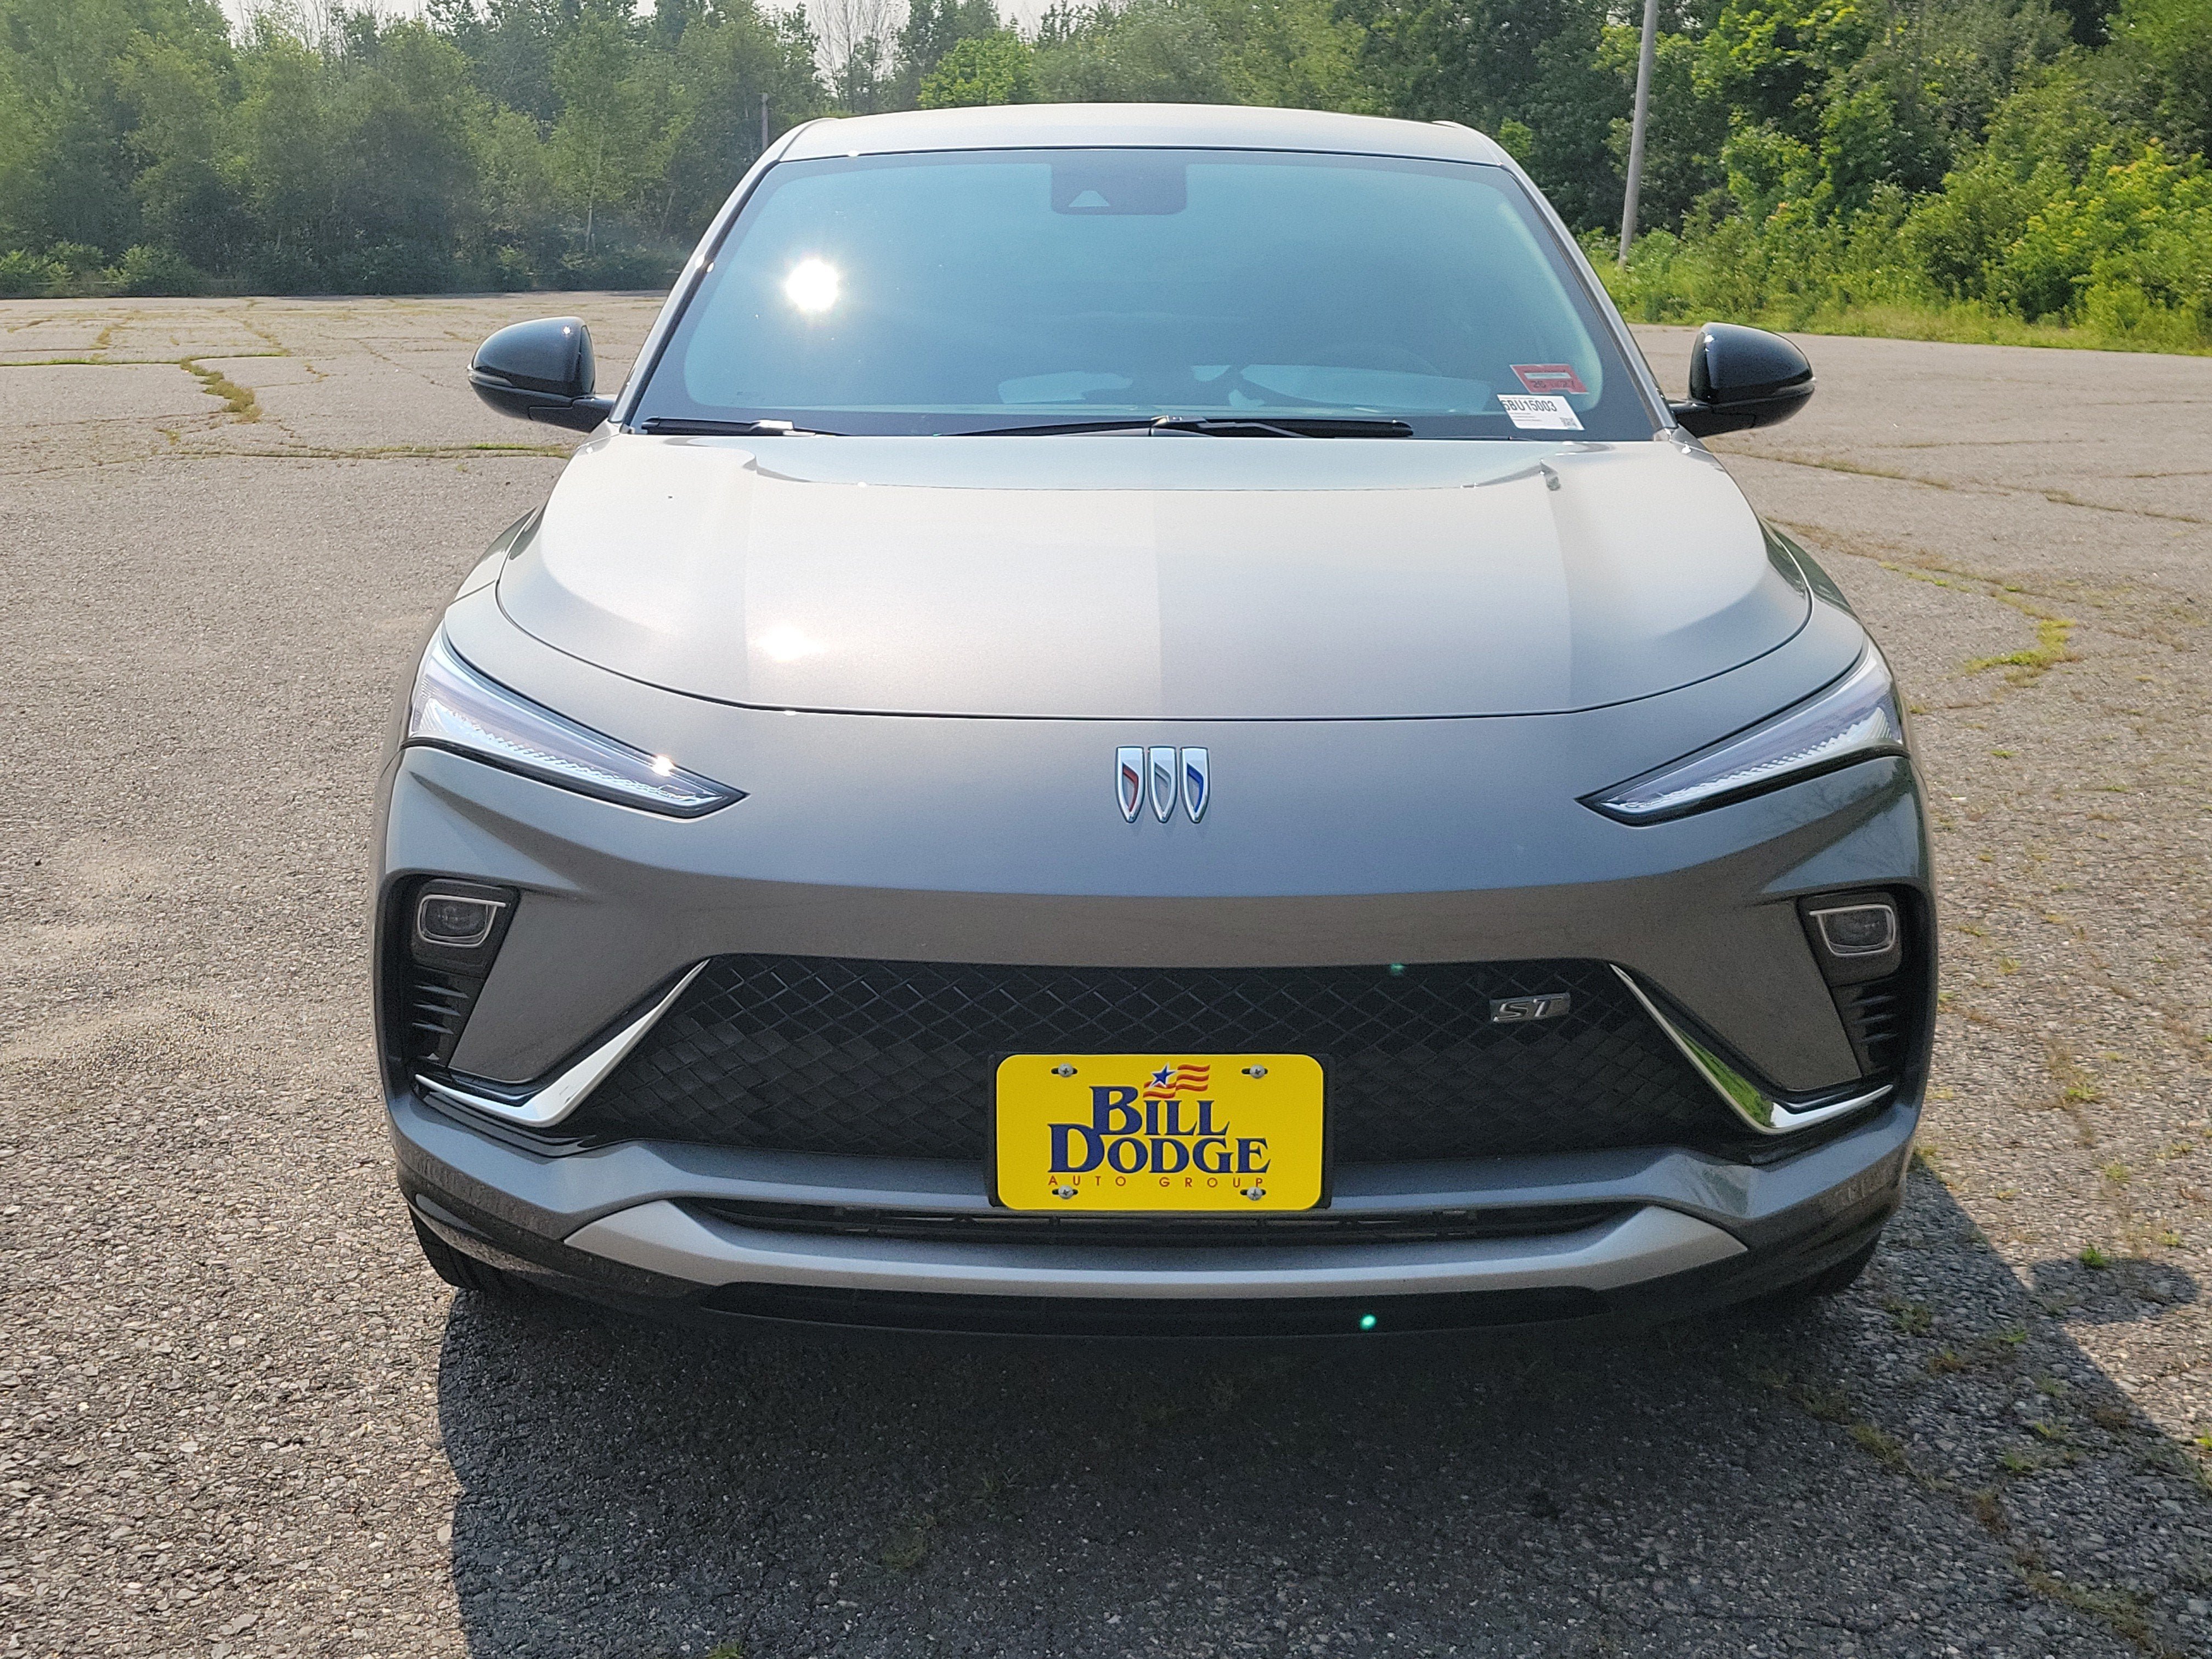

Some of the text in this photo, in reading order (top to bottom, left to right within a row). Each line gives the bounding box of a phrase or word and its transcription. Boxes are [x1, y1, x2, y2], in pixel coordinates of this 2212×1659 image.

[1493, 996, 1564, 1022] ST
[1089, 1086, 1230, 1136] BILL
[1047, 1123, 1271, 1173] DODGE
[1048, 1175, 1263, 1188] AUTO GROUP
